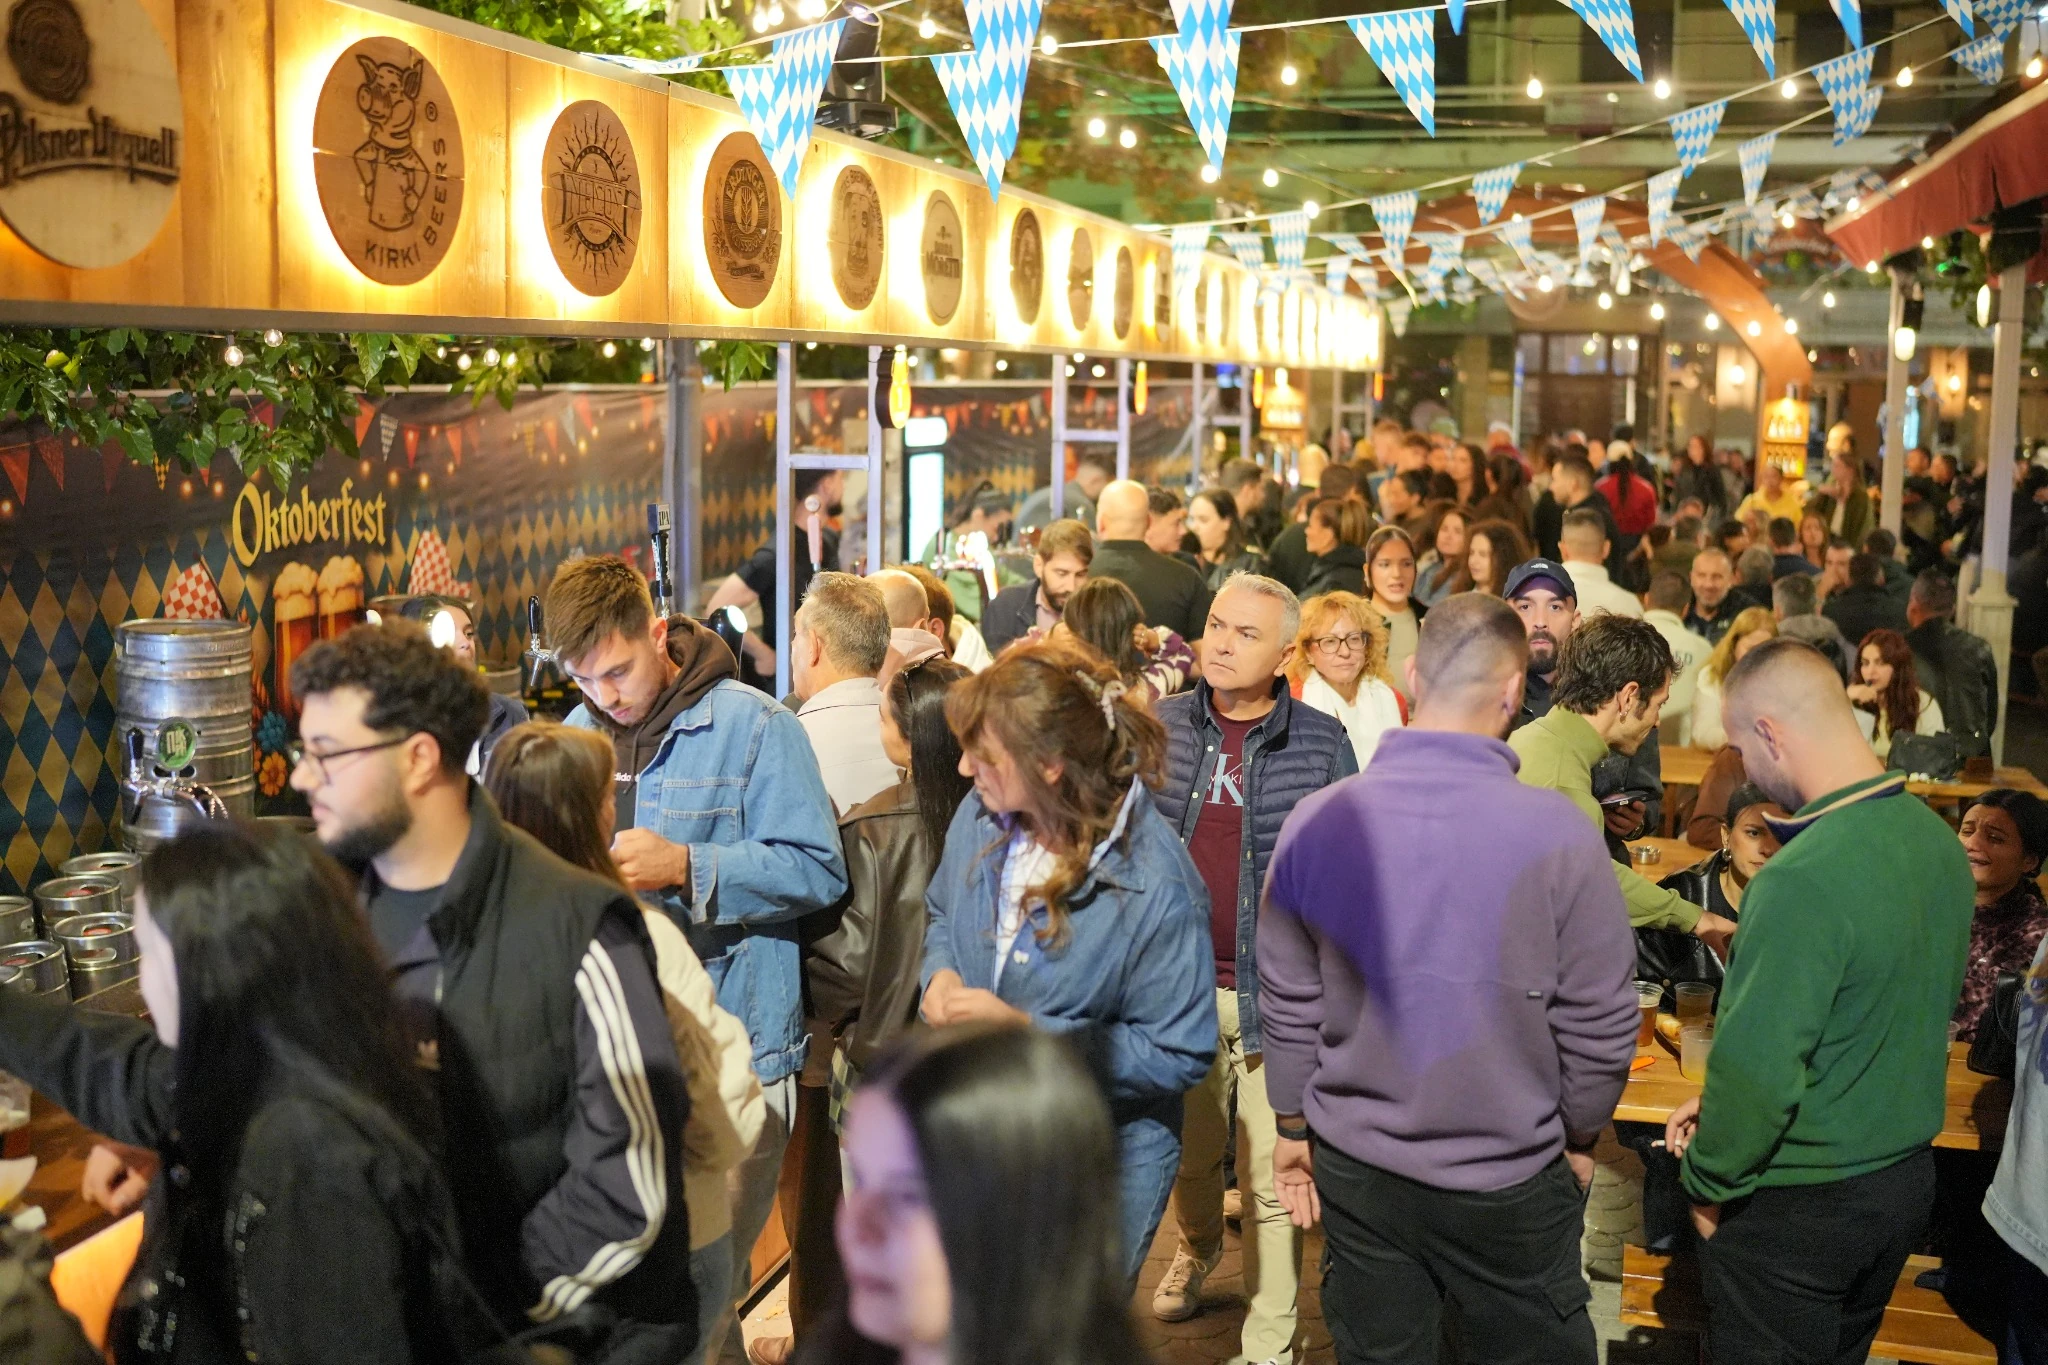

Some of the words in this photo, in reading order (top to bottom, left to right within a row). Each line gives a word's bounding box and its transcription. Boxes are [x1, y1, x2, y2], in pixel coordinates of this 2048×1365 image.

[0, 91, 90, 188] Pilsner
[87, 107, 176, 184] Urquell
[364, 239, 421, 269] KIRKI
[423, 138, 448, 246] BEERS
[725, 166, 766, 207] ERDINGER
[232, 477, 386, 567] Oktoberfest
[658, 510, 671, 526] IPA
[1206, 753, 1244, 806] K
